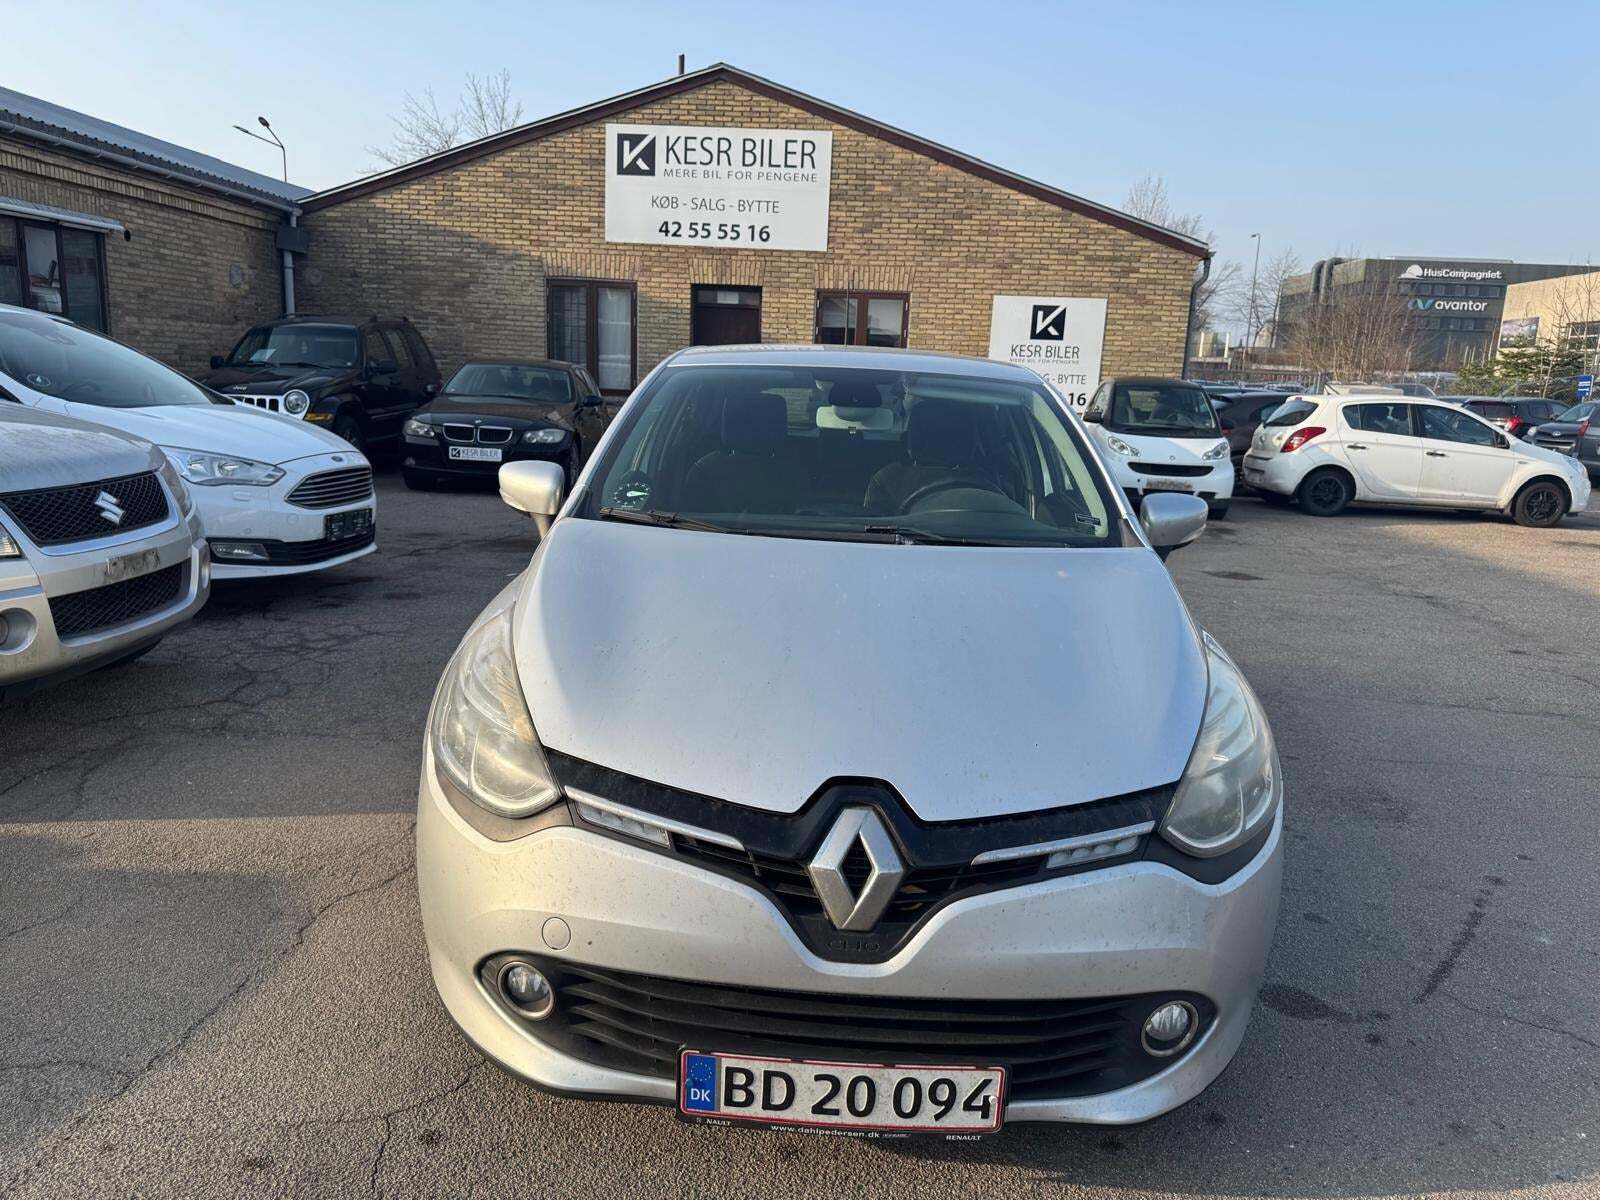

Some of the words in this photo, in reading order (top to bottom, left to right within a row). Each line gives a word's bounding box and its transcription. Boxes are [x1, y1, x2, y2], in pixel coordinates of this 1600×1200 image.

[665, 135, 732, 167] KESR
[742, 138, 817, 169] BILER
[663, 168, 698, 179] MERE
[703, 171, 722, 180] BIL
[727, 171, 753, 181] FOR
[757, 172, 817, 183] PENGENE
[651, 195, 679, 209] KØB
[691, 197, 726, 211] SALG
[737, 199, 780, 214] BYTTE
[658, 220, 682, 238] 42
[688, 222, 711, 239] 55
[717, 223, 741, 241] 55
[747, 224, 771, 243] 16
[1424, 268, 1503, 280] HusCompagniet
[1434, 300, 1488, 312] avantor
[1010, 344, 1042, 358] KESR
[1045, 345, 1080, 359] BILER
[1057, 374, 1087, 385] BYTTE
[1068, 392, 1087, 406] 16
[690, 1087, 710, 1102] DK
[724, 1066, 795, 1113] BD
[811, 1074, 876, 1118] 20
[892, 1077, 993, 1122] 094
[771, 1125, 880, 1139] www.dahlpedersen.dk
